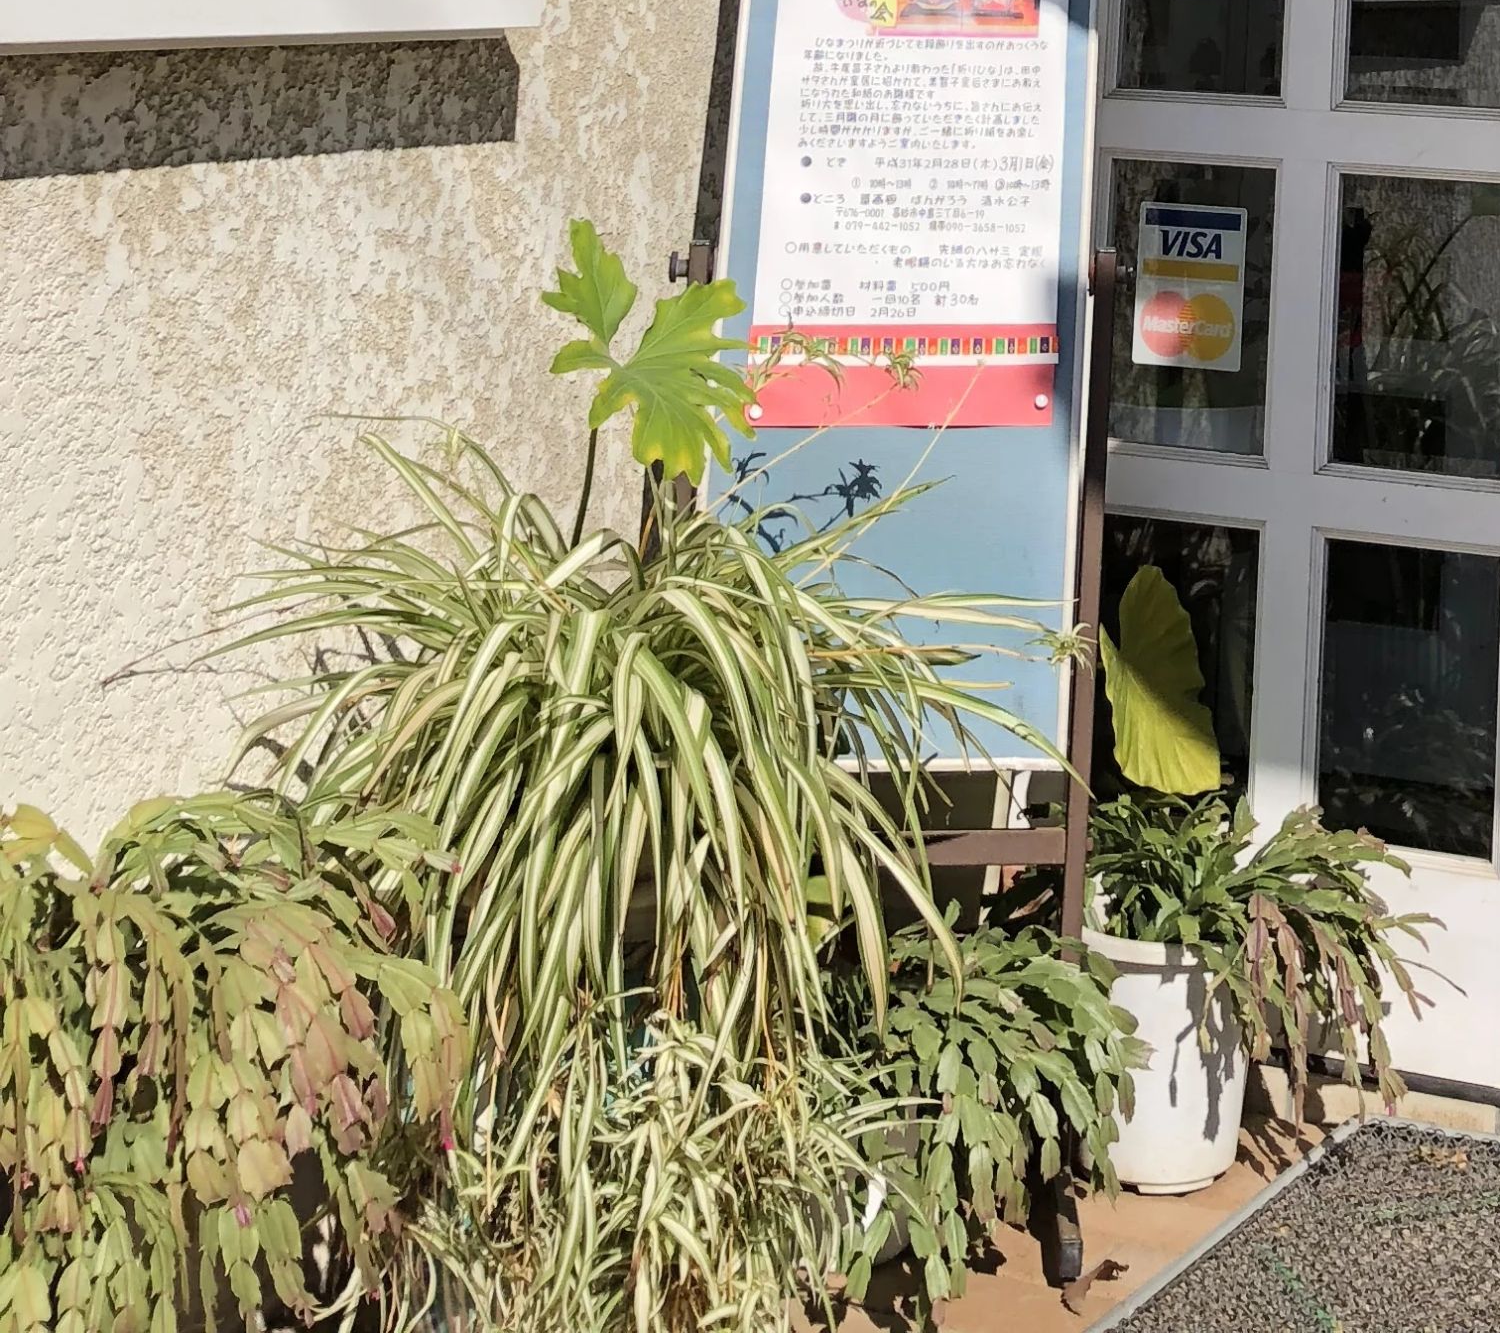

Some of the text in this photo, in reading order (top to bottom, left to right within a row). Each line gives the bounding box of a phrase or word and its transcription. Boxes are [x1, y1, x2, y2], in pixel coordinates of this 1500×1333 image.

[1159, 229, 1222, 260] VISA
[911, 280, 951, 293] 500円
[870, 306, 917, 318] 2月26日
[1142, 315, 1233, 339] MasterCard
